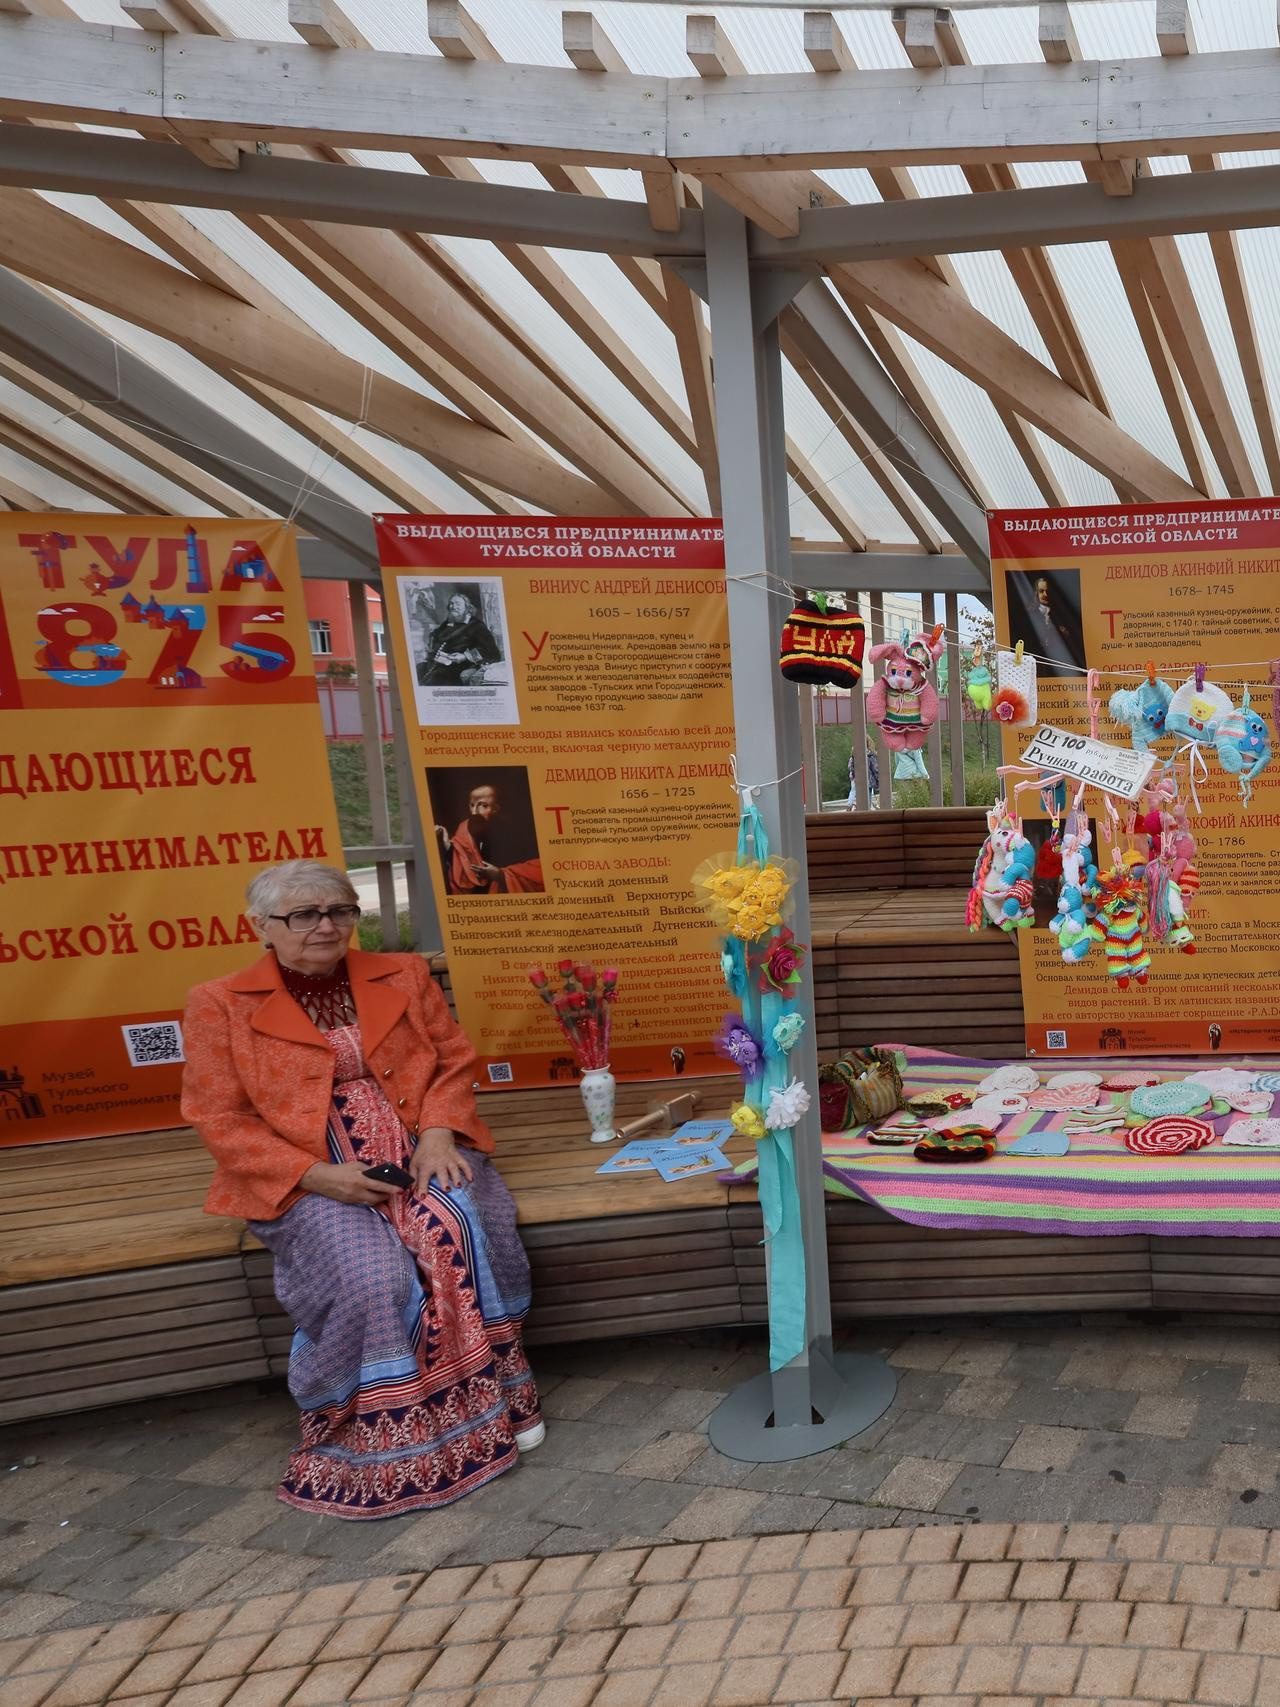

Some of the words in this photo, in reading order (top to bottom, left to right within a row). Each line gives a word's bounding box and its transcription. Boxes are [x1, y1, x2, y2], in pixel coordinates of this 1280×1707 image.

[1004, 516, 1129, 532] ВЫДАЮЩИЕСЯ
[396, 525, 550, 539] ВЫДАЮЩИЕСЯ
[555, 527, 724, 542] ПРЕДПРИНИМАТЕ
[1070, 529, 1156, 546] ТУЛЬСКОЙ
[1161, 528, 1238, 542] ОБЛАСТИ
[480, 543, 583, 557] ТУЛЬСКОЙ
[588, 546, 676, 558] ОБЛАСТИ
[18, 523, 285, 597] ТУЛА
[1105, 564, 1168, 580] ДЕМИДОВ
[1172, 559, 1234, 576] АКИНФИЙ
[529, 580, 590, 594] ВИНИУС
[594, 577, 651, 595] АНДРЕЙ
[655, 579, 727, 596] ДЕНИСОВ
[1169, 586, 1202, 596] 1678–
[1207, 584, 1234, 595] 1745
[589, 607, 620, 618] 1605
[636, 607, 690, 619] 1656/57
[33, 595, 296, 689] 875
[784, 624, 856, 655] УЛА
[1101, 643, 1126, 651] душе-
[1135, 640, 1202, 648] заводовладелец
[544, 701, 584, 712] позднее
[585, 701, 606, 711] 1637
[1038, 728, 1060, 745] От
[1061, 737, 1086, 750] 100
[1085, 748, 1110, 761] рублей
[545, 767, 617, 783] ДЕМИДОВ
[620, 766, 675, 780] НИКИТА
[1027, 746, 1078, 770] Ручная
[1080, 765, 1135, 793] работа
[621, 789, 649, 799] 1656
[665, 786, 696, 797] 1725
[1219, 837, 1246, 847] 1786
[0, 827, 328, 884] ПРИНИМАТЕЛИ
[552, 857, 611, 872] ОСНОВАЛ
[613, 857, 671, 869] ЗАВОДЫ:
[553, 878, 605, 890] Тульский
[608, 875, 669, 887] доменный
[446, 894, 555, 910] Верхнотагильский
[557, 894, 615, 905] доменный
[453, 945, 554, 956] Нижнетагильский
[557, 937, 678, 953] железноделательный
[1075, 1011, 1125, 1019] авторство
[1128, 1008, 1180, 1020] указывает
[1183, 1008, 1244, 1018] сокращение
[42, 1067, 95, 1083] Музей
[47, 1083, 129, 1100] Тульского
